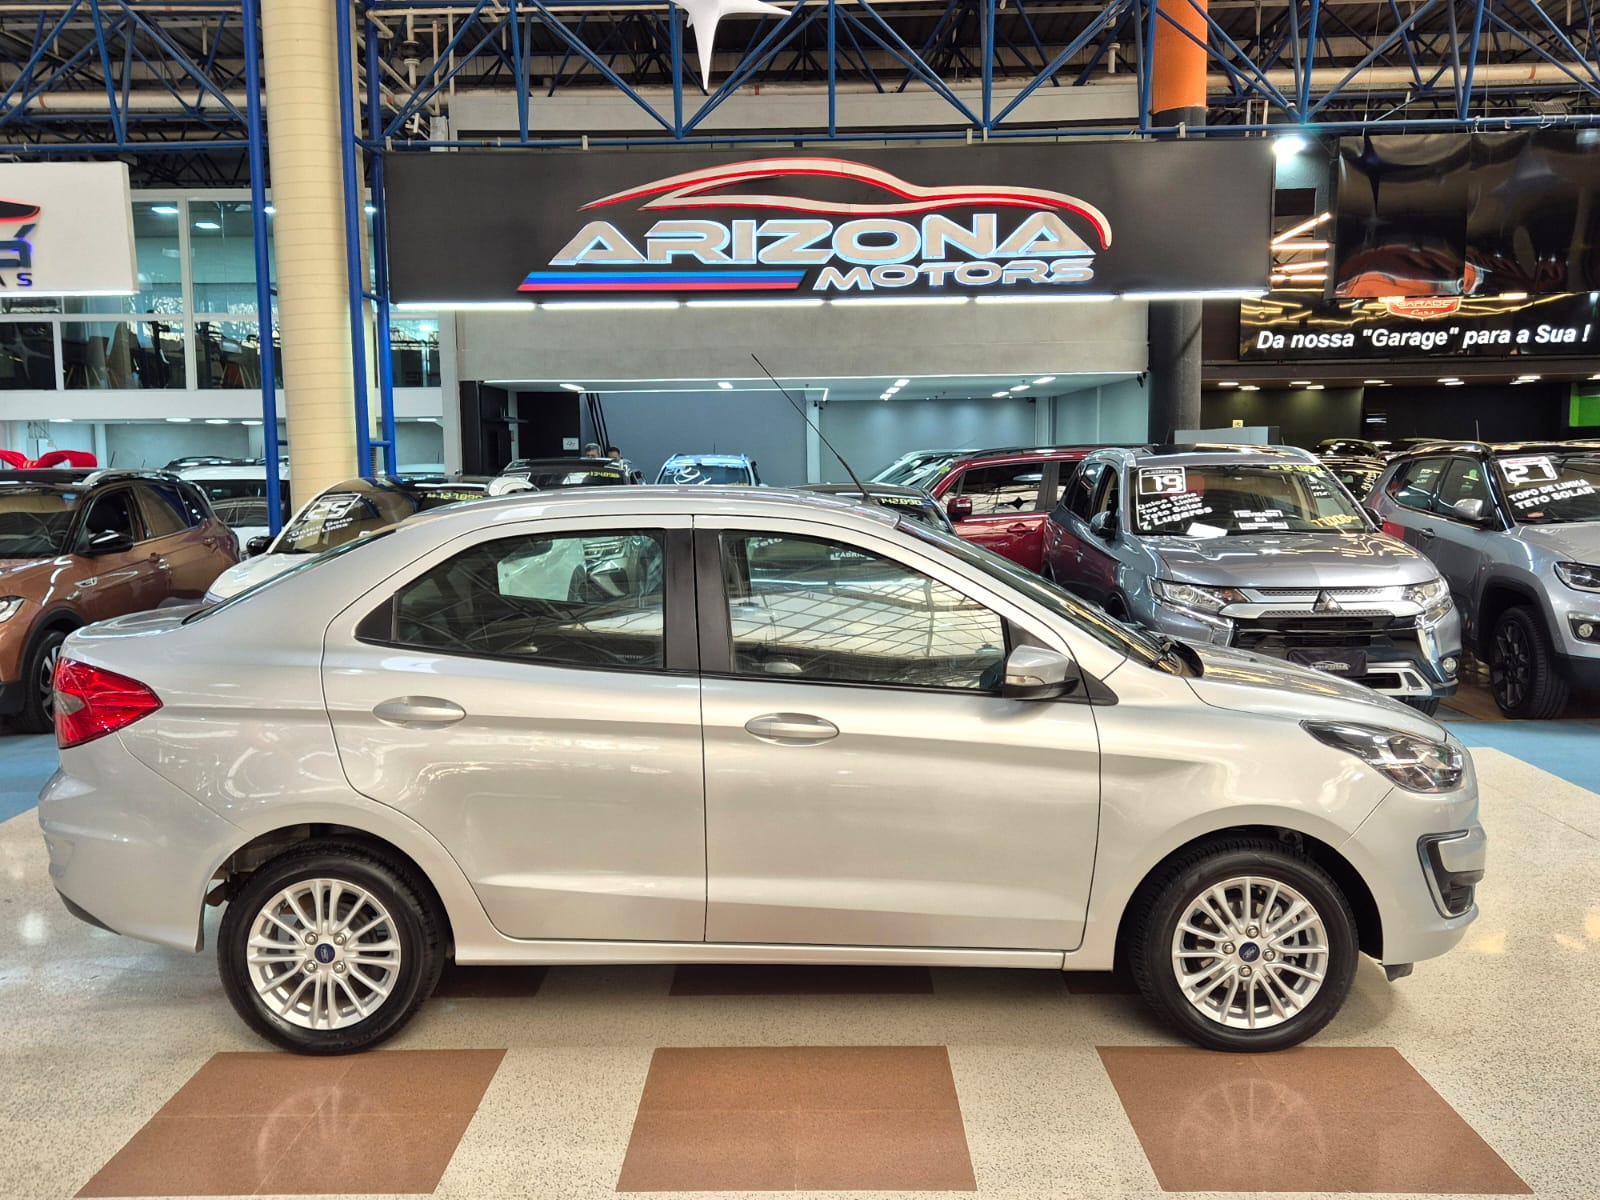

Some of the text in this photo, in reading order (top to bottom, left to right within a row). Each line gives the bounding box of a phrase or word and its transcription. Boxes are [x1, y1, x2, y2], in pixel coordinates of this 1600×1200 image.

[548, 211, 1096, 266] ARIZONA
[812, 257, 1095, 292] MOTORS
[1256, 330, 1285, 350] Da
[1290, 331, 1355, 349] nossa
[1362, 327, 1459, 351] "Garage"
[1463, 329, 1511, 350] para
[1516, 329, 1530, 344] a
[1535, 325, 1577, 344] Sua
[1506, 464, 1555, 482] 21
[1153, 475, 1183, 492] 19
[1508, 488, 1539, 501] TOPO
[1539, 484, 1556, 494] DE
[1514, 486, 1596, 509] TETO SOLAR
[1142, 503, 1203, 520] Teto Solar
[1153, 507, 1213, 526] Lugares
